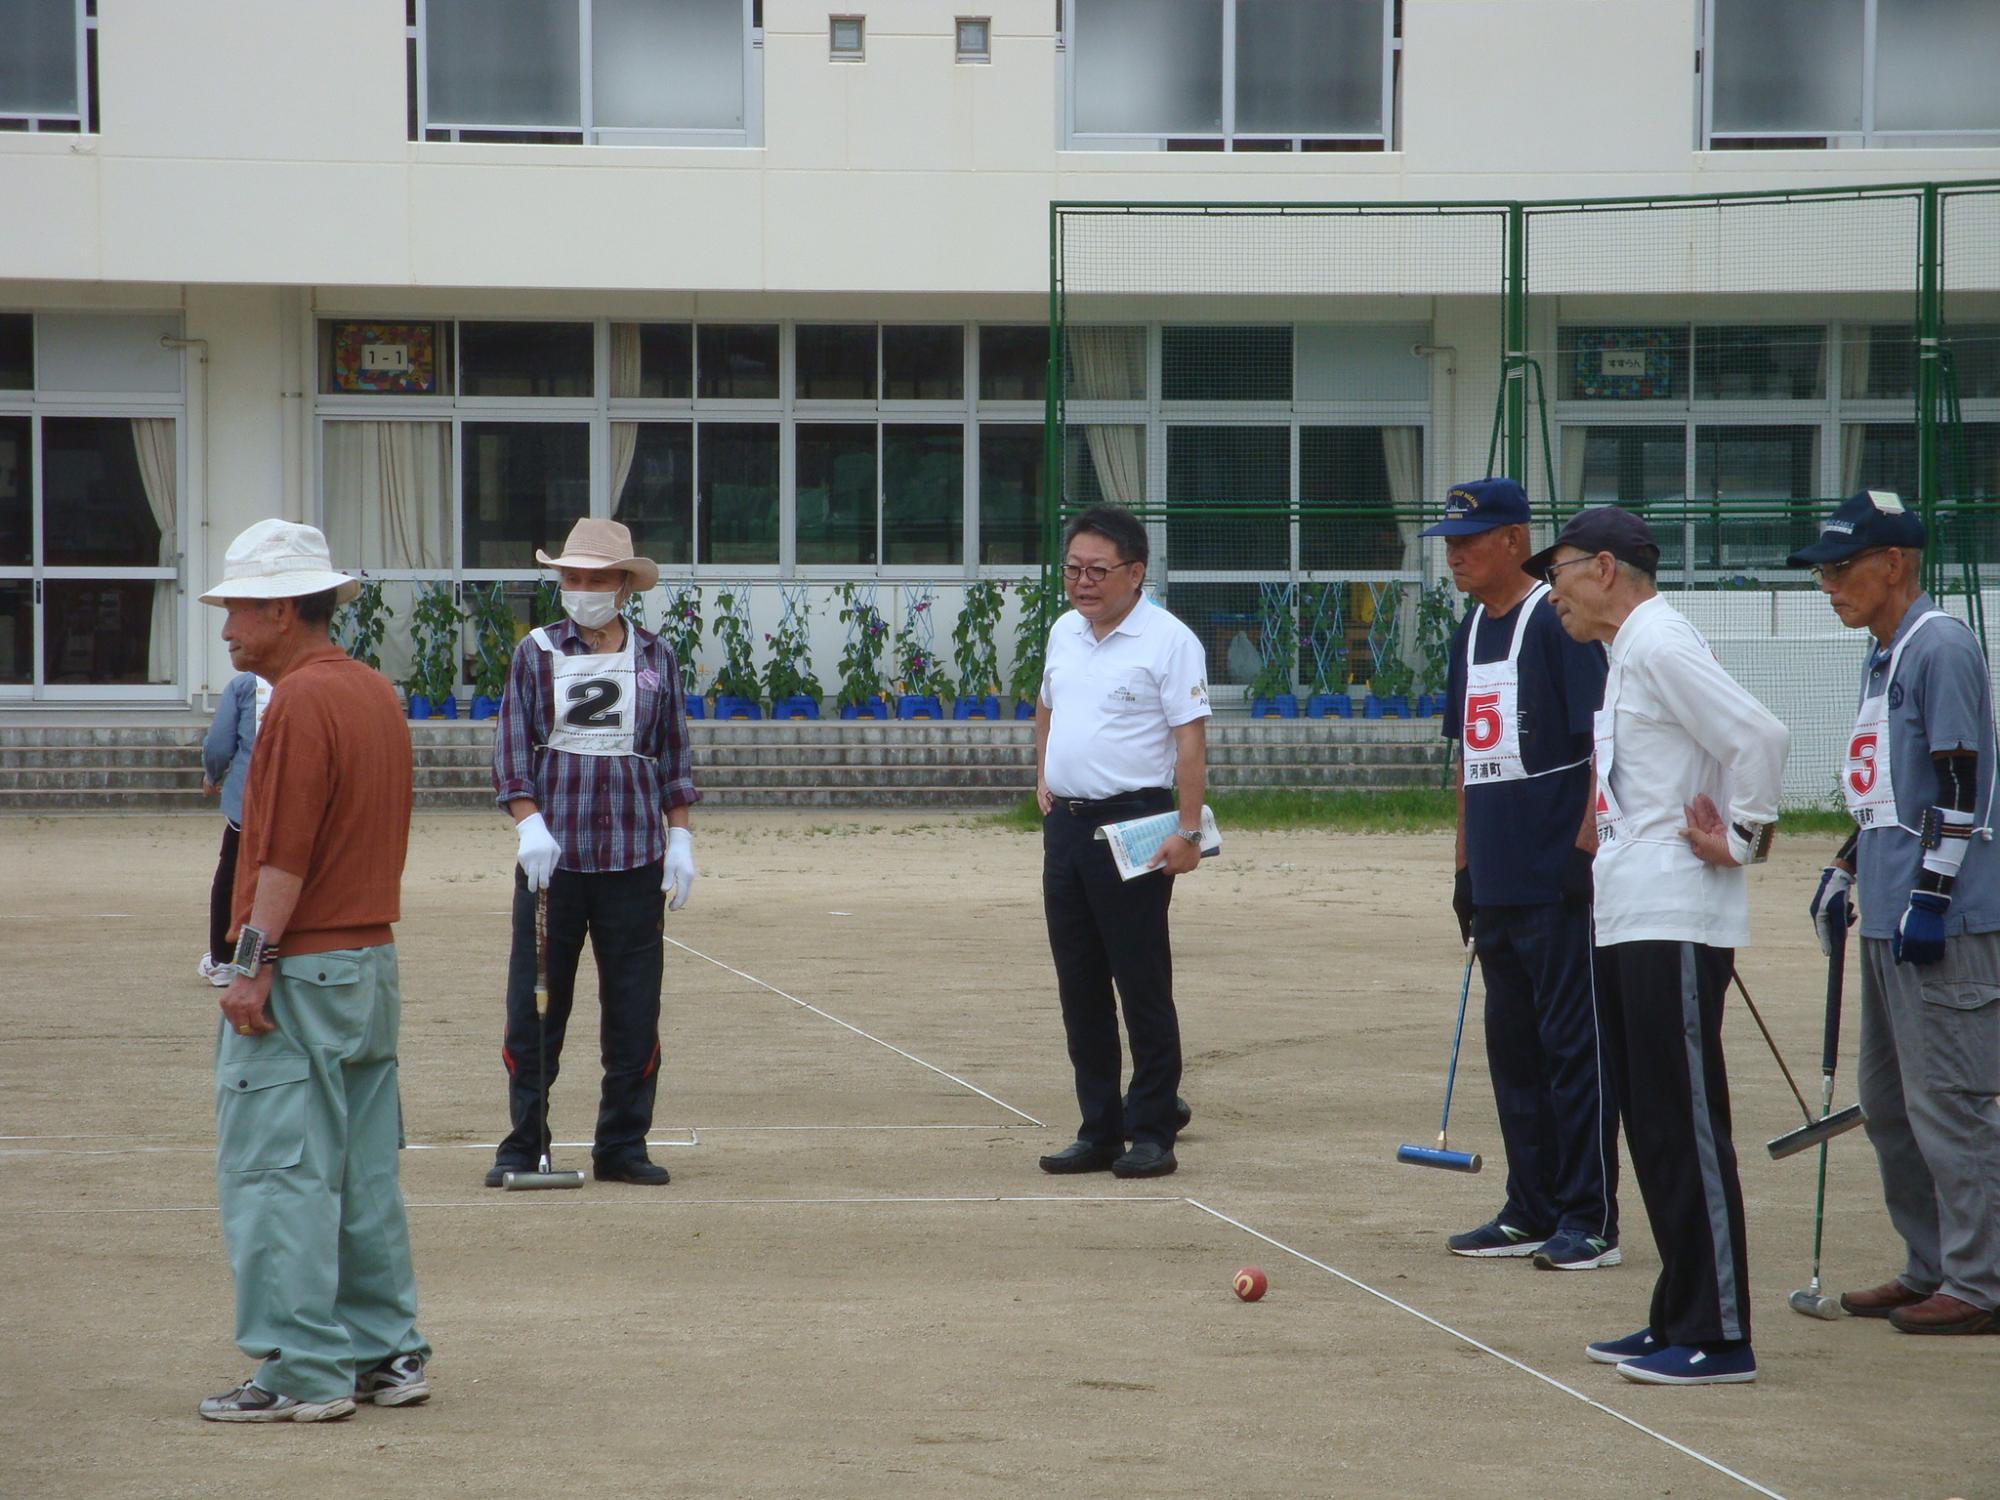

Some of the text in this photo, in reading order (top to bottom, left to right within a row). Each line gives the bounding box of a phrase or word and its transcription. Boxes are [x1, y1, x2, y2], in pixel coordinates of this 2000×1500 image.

[368, 350, 402, 365] 1-1
[563, 677, 623, 729] 2
[1464, 690, 1504, 753] 5
[1848, 731, 1879, 798] 3
